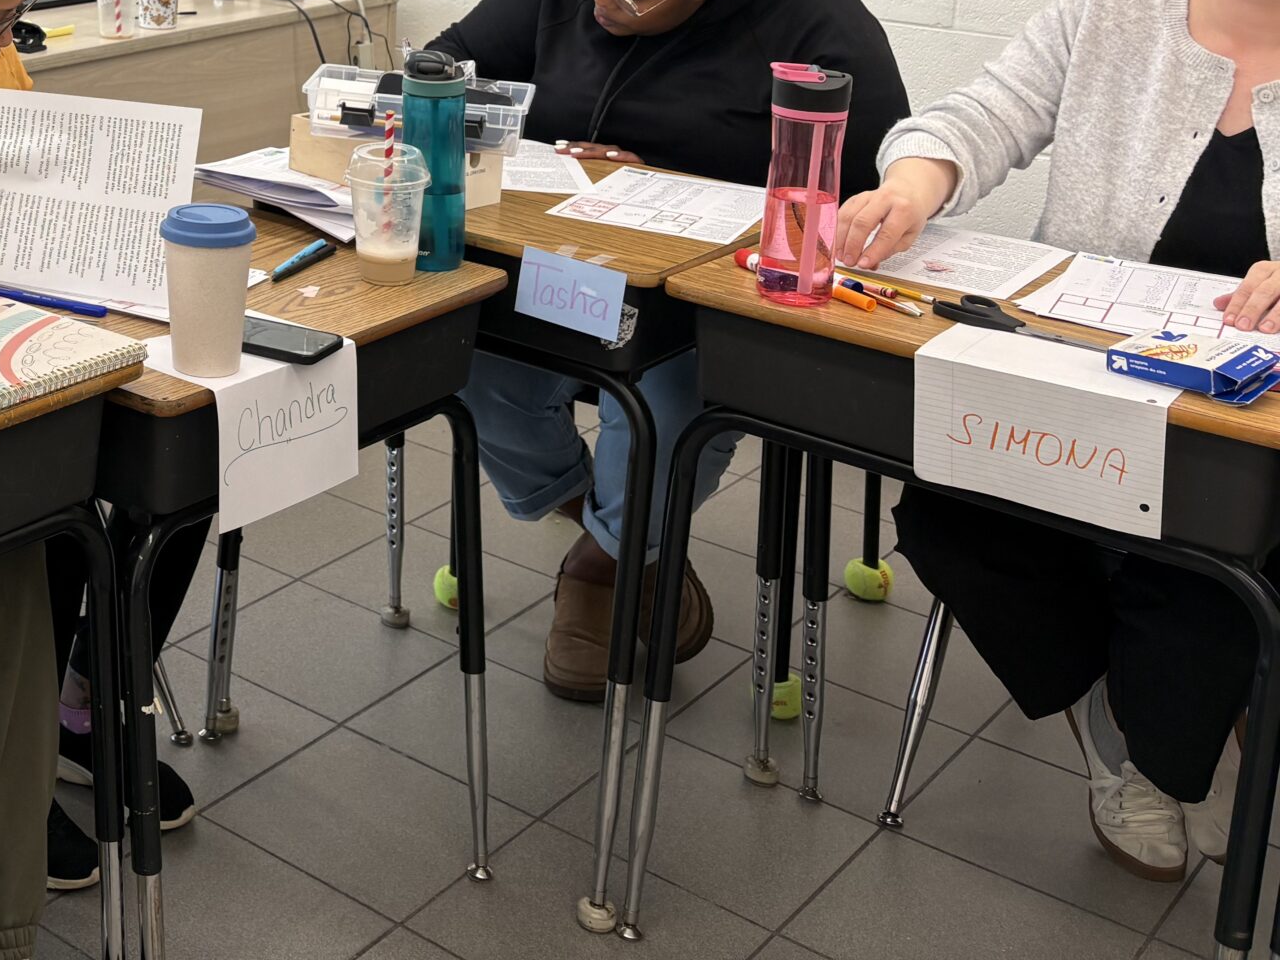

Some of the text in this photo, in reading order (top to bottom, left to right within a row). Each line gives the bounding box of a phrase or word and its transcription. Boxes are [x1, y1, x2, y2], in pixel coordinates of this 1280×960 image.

[523, 260, 609, 322] Tasha
[237, 382, 337, 452] Chandra
[946, 412, 1129, 485] SIMONA
